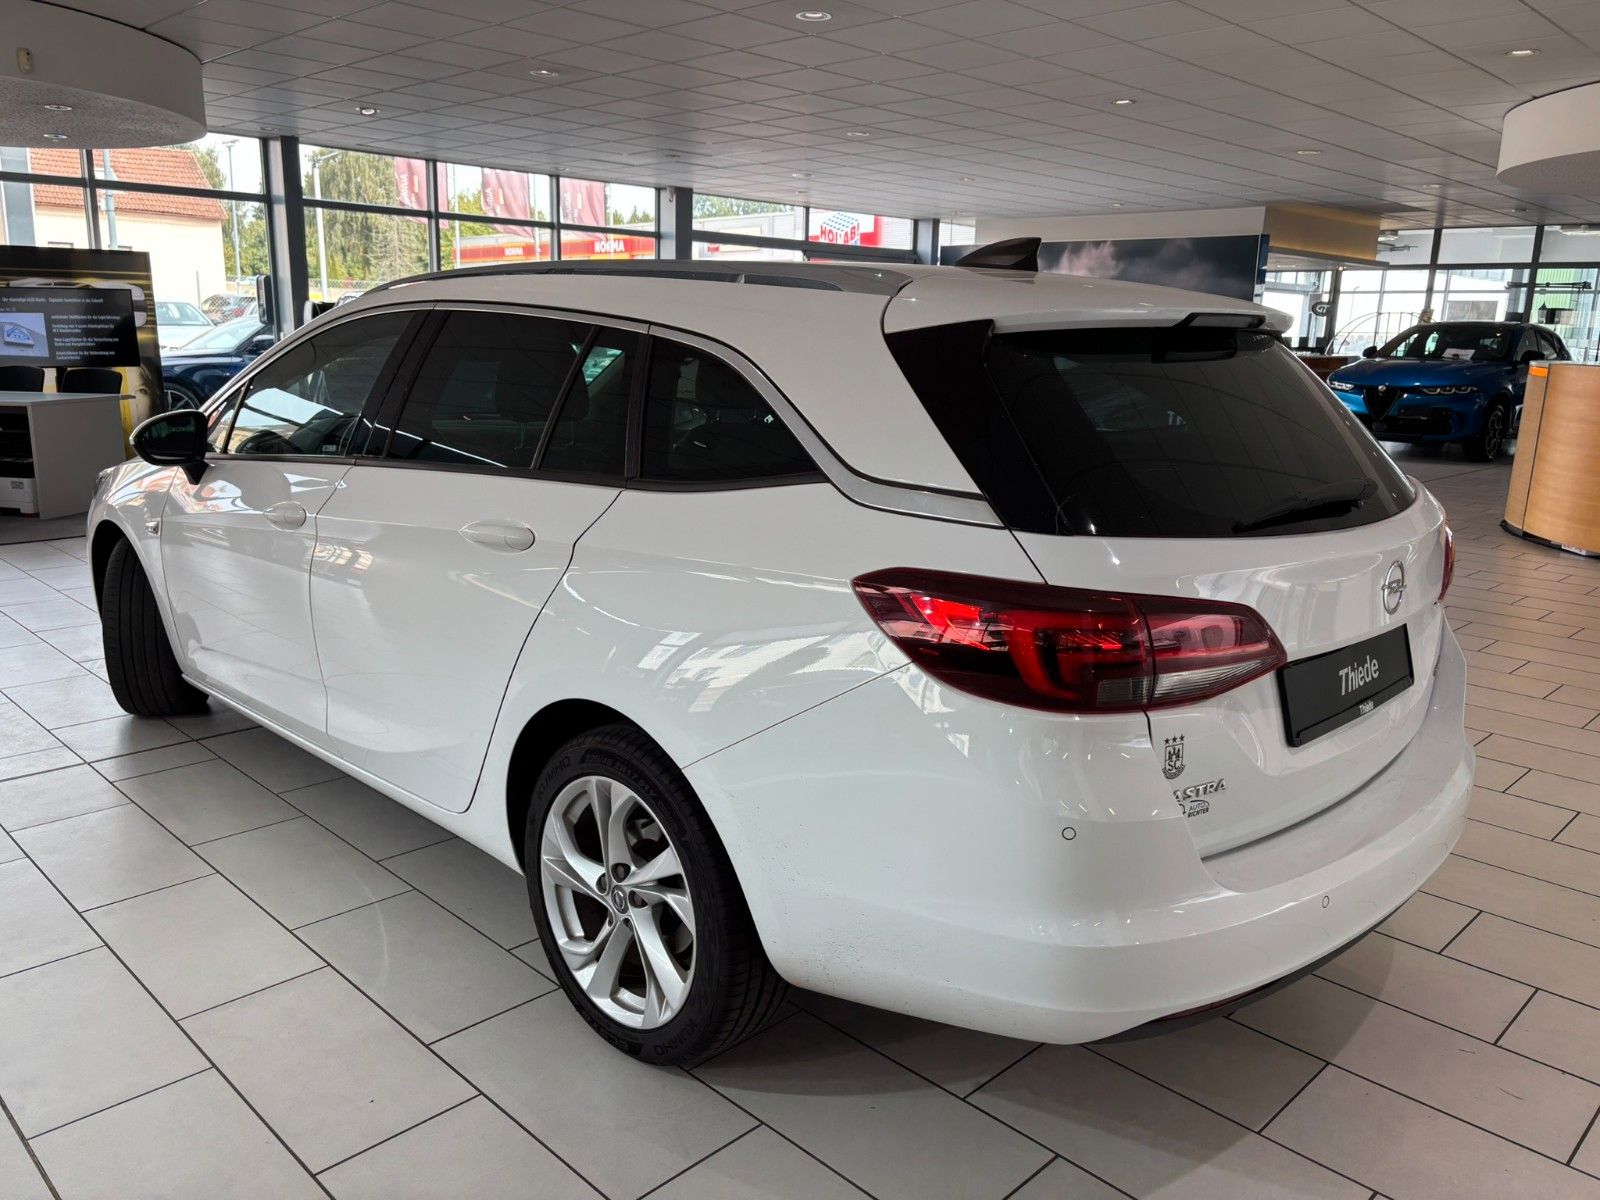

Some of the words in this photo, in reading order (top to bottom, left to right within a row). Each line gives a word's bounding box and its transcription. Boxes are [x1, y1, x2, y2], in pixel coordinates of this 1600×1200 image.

[594, 239, 625, 253] NORMA
[1339, 655, 1379, 696] Thiede
[1173, 778, 1226, 801] ASTRA
[1189, 801, 1205, 811] AUTO
